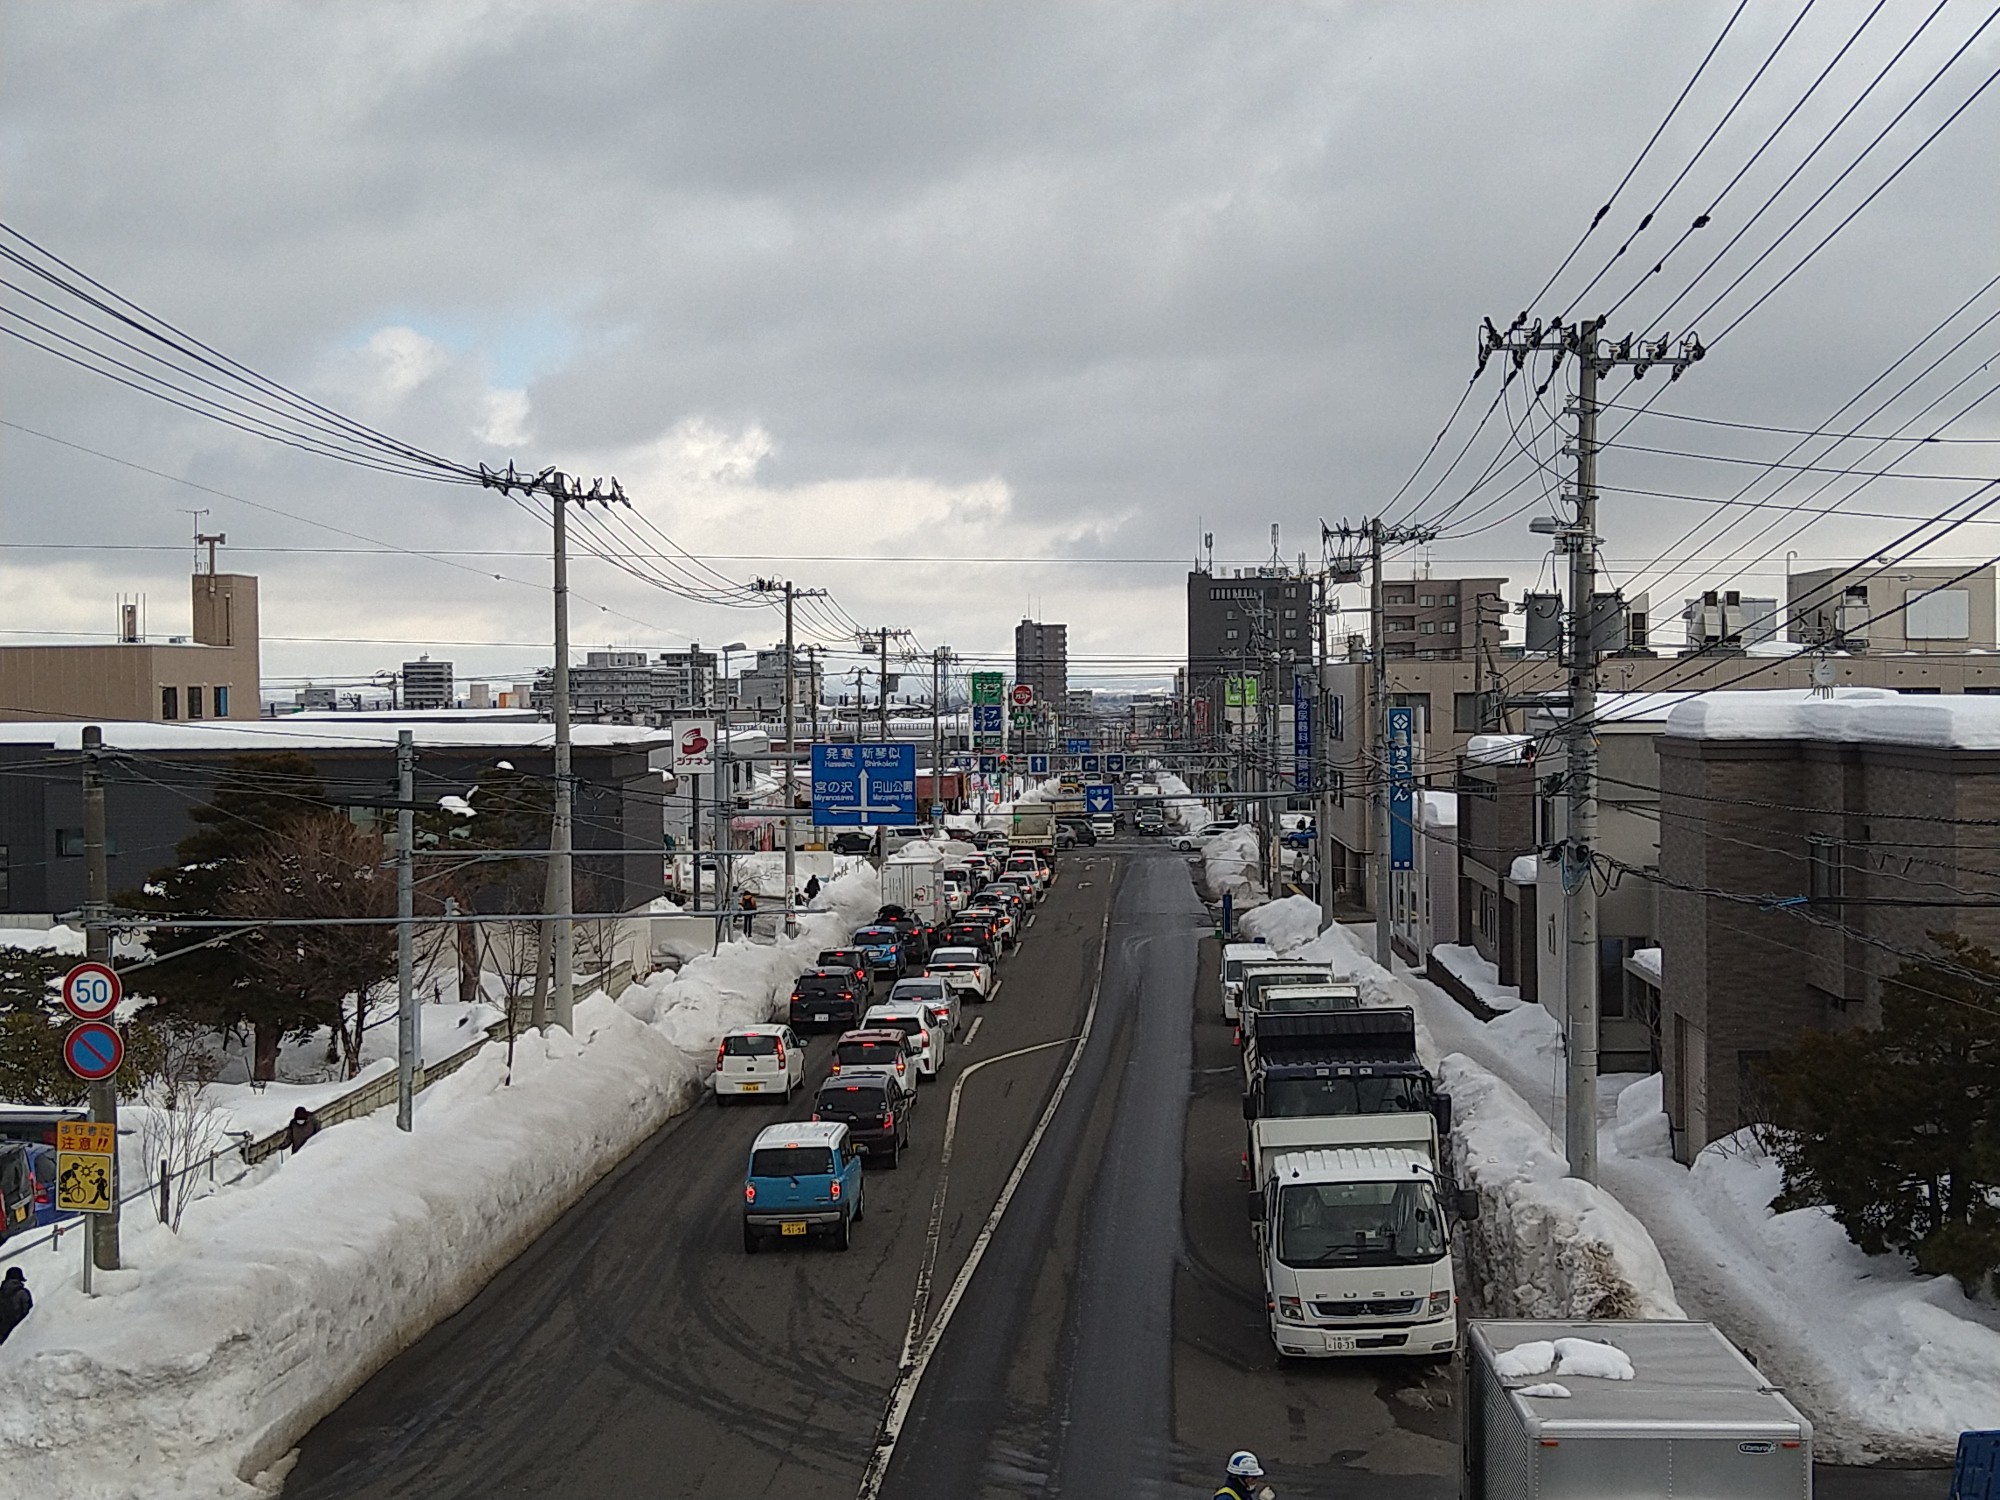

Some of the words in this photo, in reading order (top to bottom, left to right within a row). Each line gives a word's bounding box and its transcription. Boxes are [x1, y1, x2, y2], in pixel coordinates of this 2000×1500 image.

[862, 747, 901, 760] 新琴似
[814, 781, 854, 793] 宮の沢
[872, 781, 913, 793] 円山公園
[76, 979, 107, 1004] 50
[61, 1124, 110, 1137] 歩行者に
[1315, 1289, 1415, 1300] FUSO
